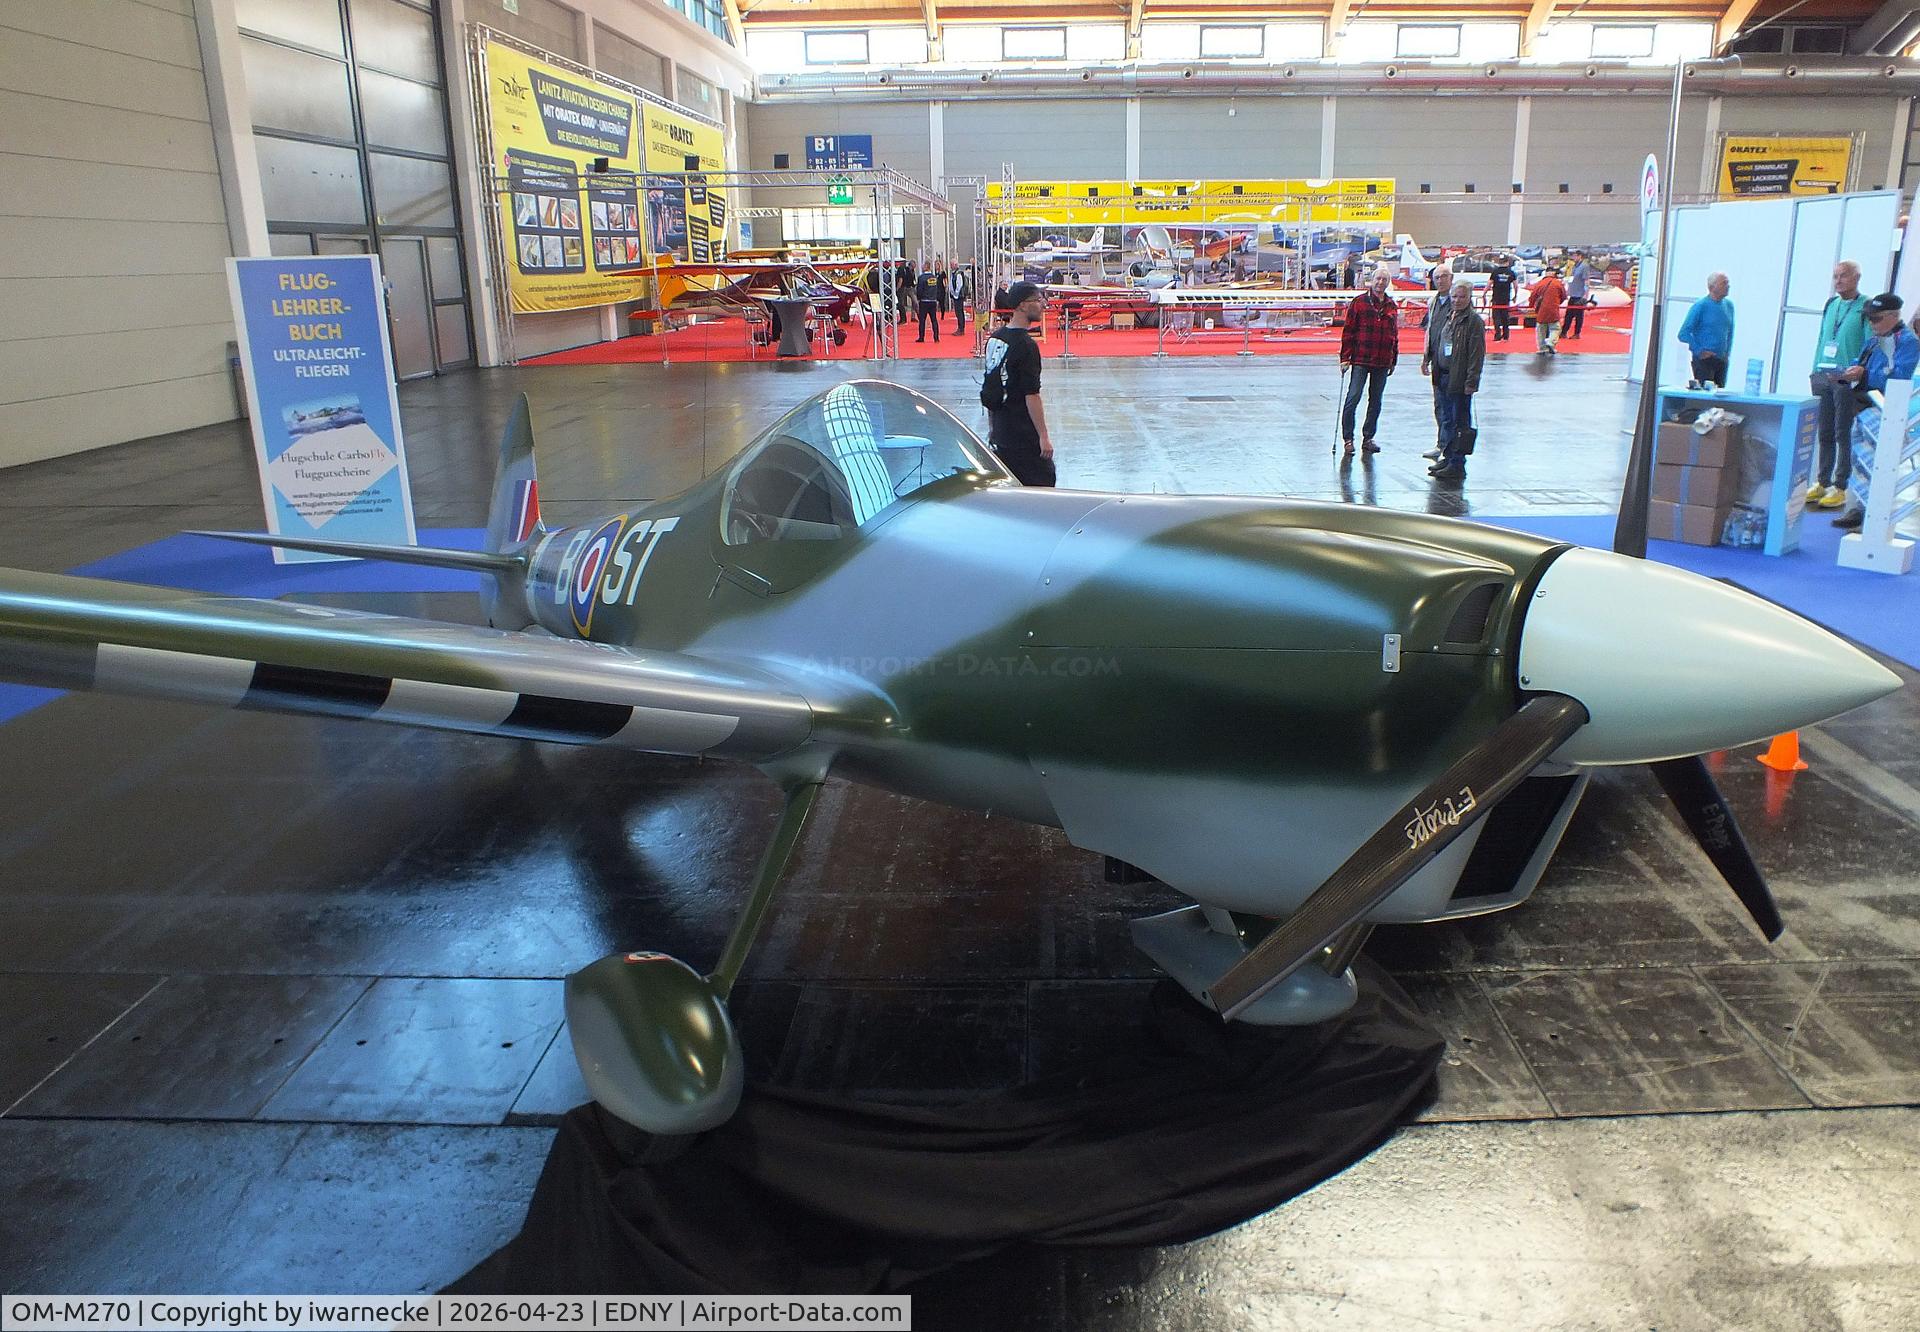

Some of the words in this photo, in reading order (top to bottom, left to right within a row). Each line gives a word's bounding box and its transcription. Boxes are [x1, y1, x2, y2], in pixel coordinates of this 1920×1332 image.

[537, 79, 561, 100] LANITZ
[562, 89, 588, 109] AVIATION
[588, 96, 608, 115] DESIGN
[608, 101, 628, 120] CHANGE
[543, 103, 555, 119] MIT
[555, 106, 580, 126] ORATEX
[669, 123, 694, 147] ORATEX
[814, 137, 834, 152] B1
[279, 273, 337, 291] FLUG-
[272, 298, 351, 316] LEHRER-
[288, 323, 342, 341] BUCH
[273, 347, 366, 362] ULTRALEICHT-
[295, 365, 350, 378] FLIEGEN
[281, 450, 335, 465] Flugschule
[294, 467, 371, 481] Fluggutscheine
[602, 517, 680, 606] ST
[1404, 786, 1477, 849] E-Props
